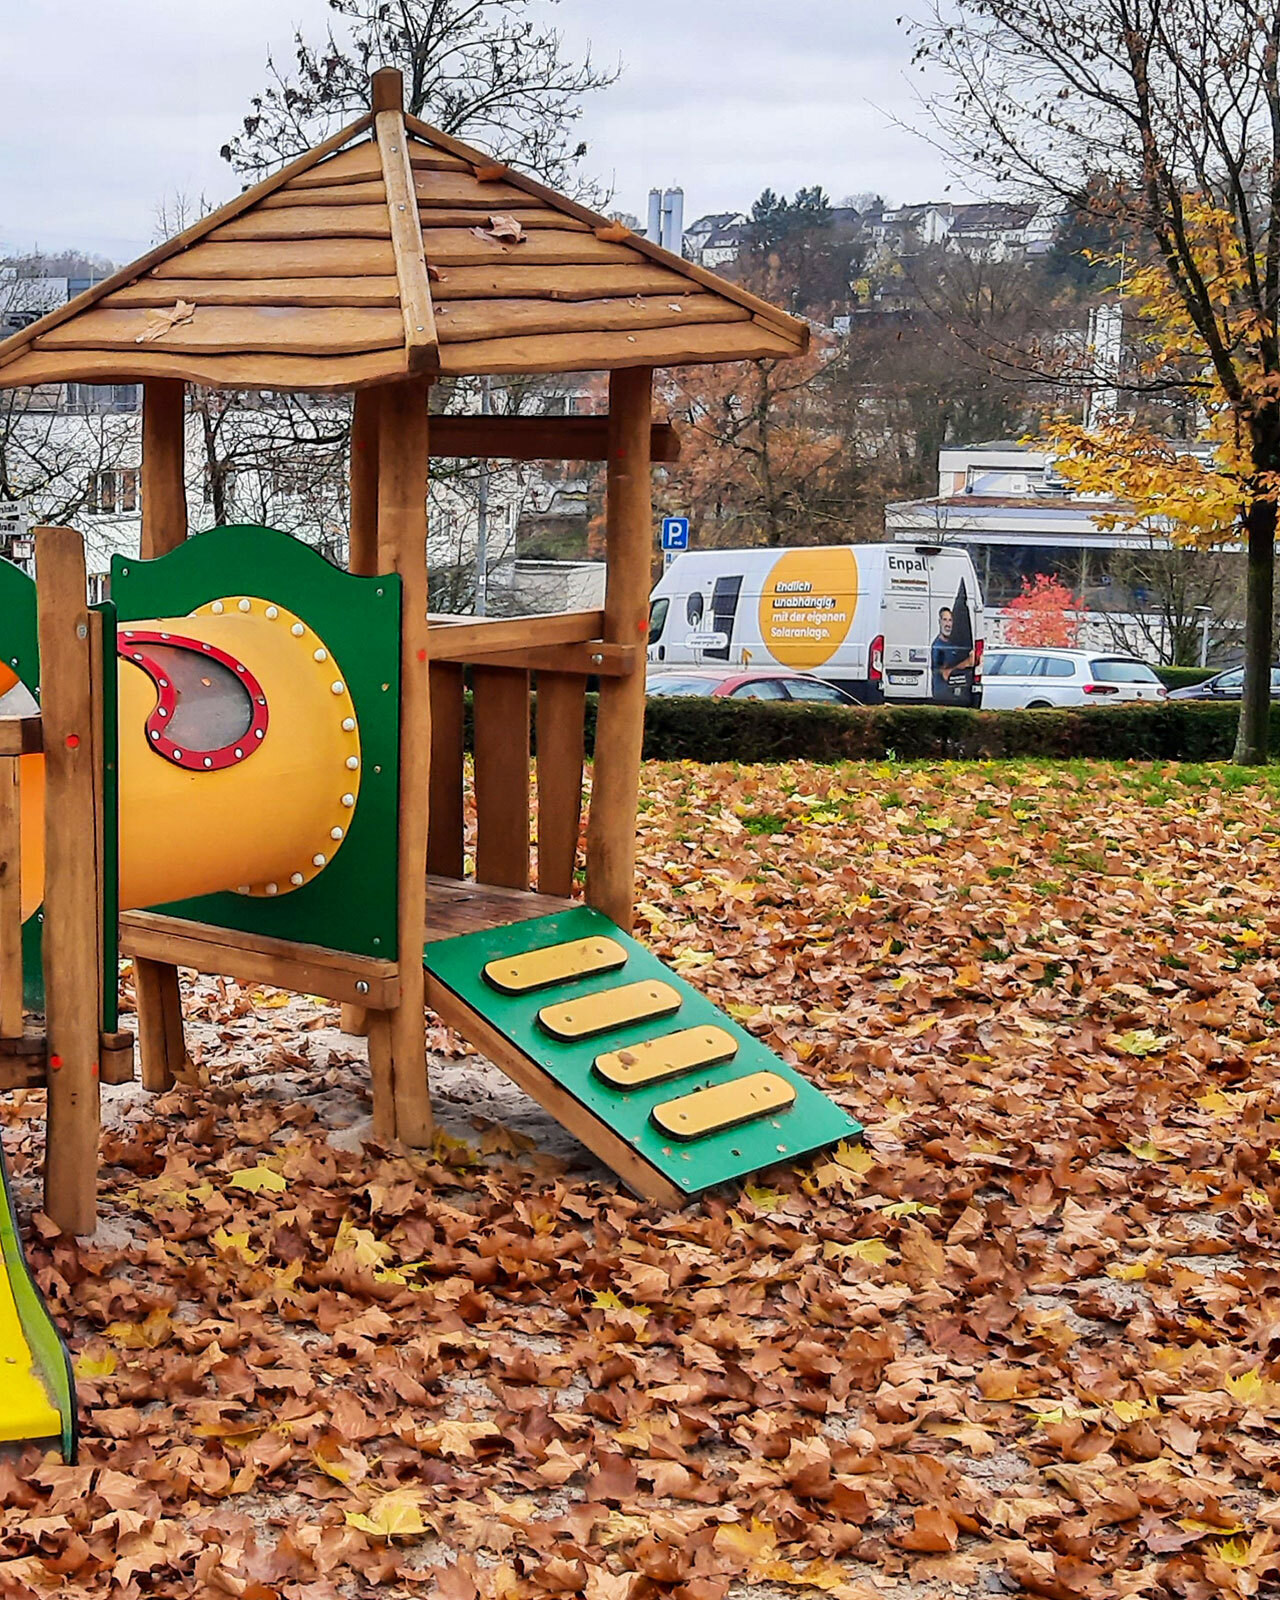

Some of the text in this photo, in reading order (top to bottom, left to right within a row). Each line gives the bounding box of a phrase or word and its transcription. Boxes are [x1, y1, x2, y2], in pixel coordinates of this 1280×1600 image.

[668, 522, 683, 546] P
[775, 581, 811, 592] Endlich
[773, 596, 835, 610] unabhängig,
[772, 611, 846, 625] mit der eigenen
[770, 627, 831, 640] Solaranlage.
